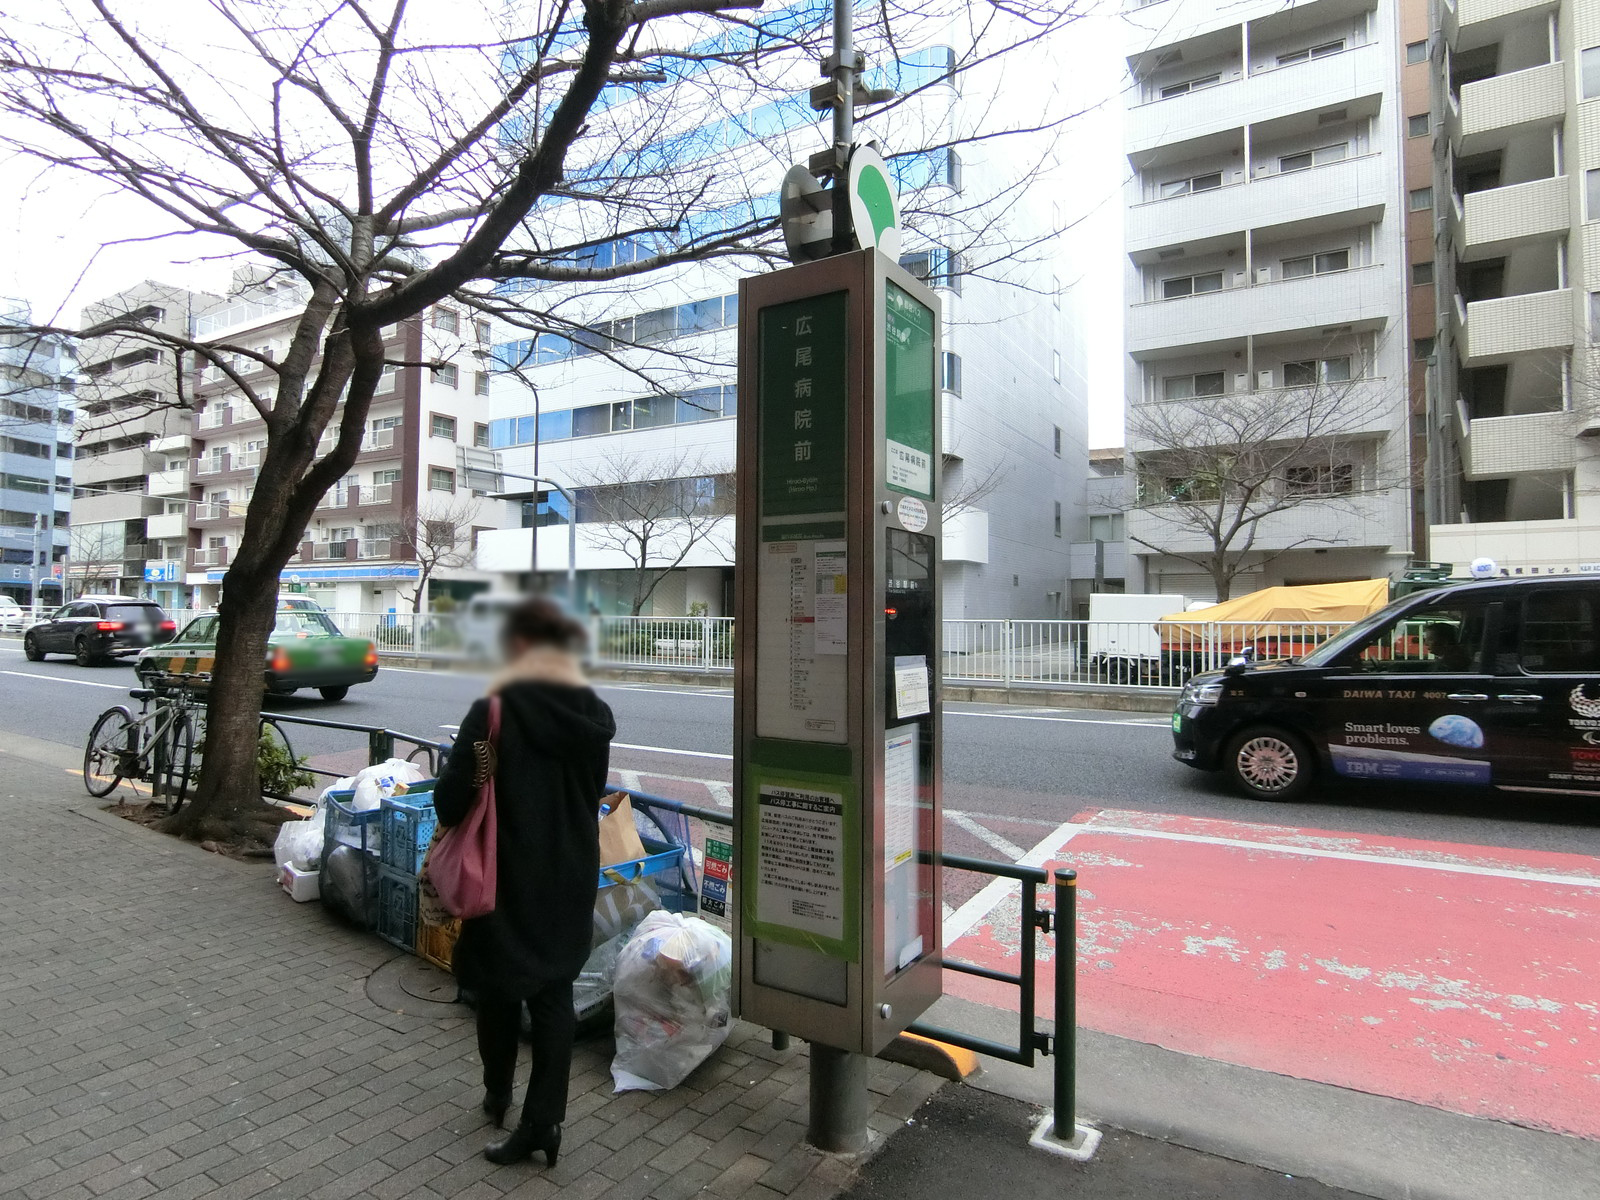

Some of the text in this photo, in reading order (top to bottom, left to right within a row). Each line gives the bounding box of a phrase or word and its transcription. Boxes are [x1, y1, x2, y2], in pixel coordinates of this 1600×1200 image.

[794, 315, 813, 461] 広尾病院前
[1343, 689, 1383, 699] DAIWA
[1387, 689, 1416, 699] TAXI
[1344, 721, 1421, 735] Smart loves
[1568, 718, 1597, 726] TOKYO
[1345, 732, 1409, 746] problems.
[1346, 762, 1379, 775] IBM
[1548, 773, 1572, 781] START
[769, 798, 835, 812] バス停工事に関するご案内
[706, 859, 728, 874] 可燃ごみ
[703, 879, 726, 894] 不燃ごみ
[702, 897, 725, 910] 粗大ごみ
